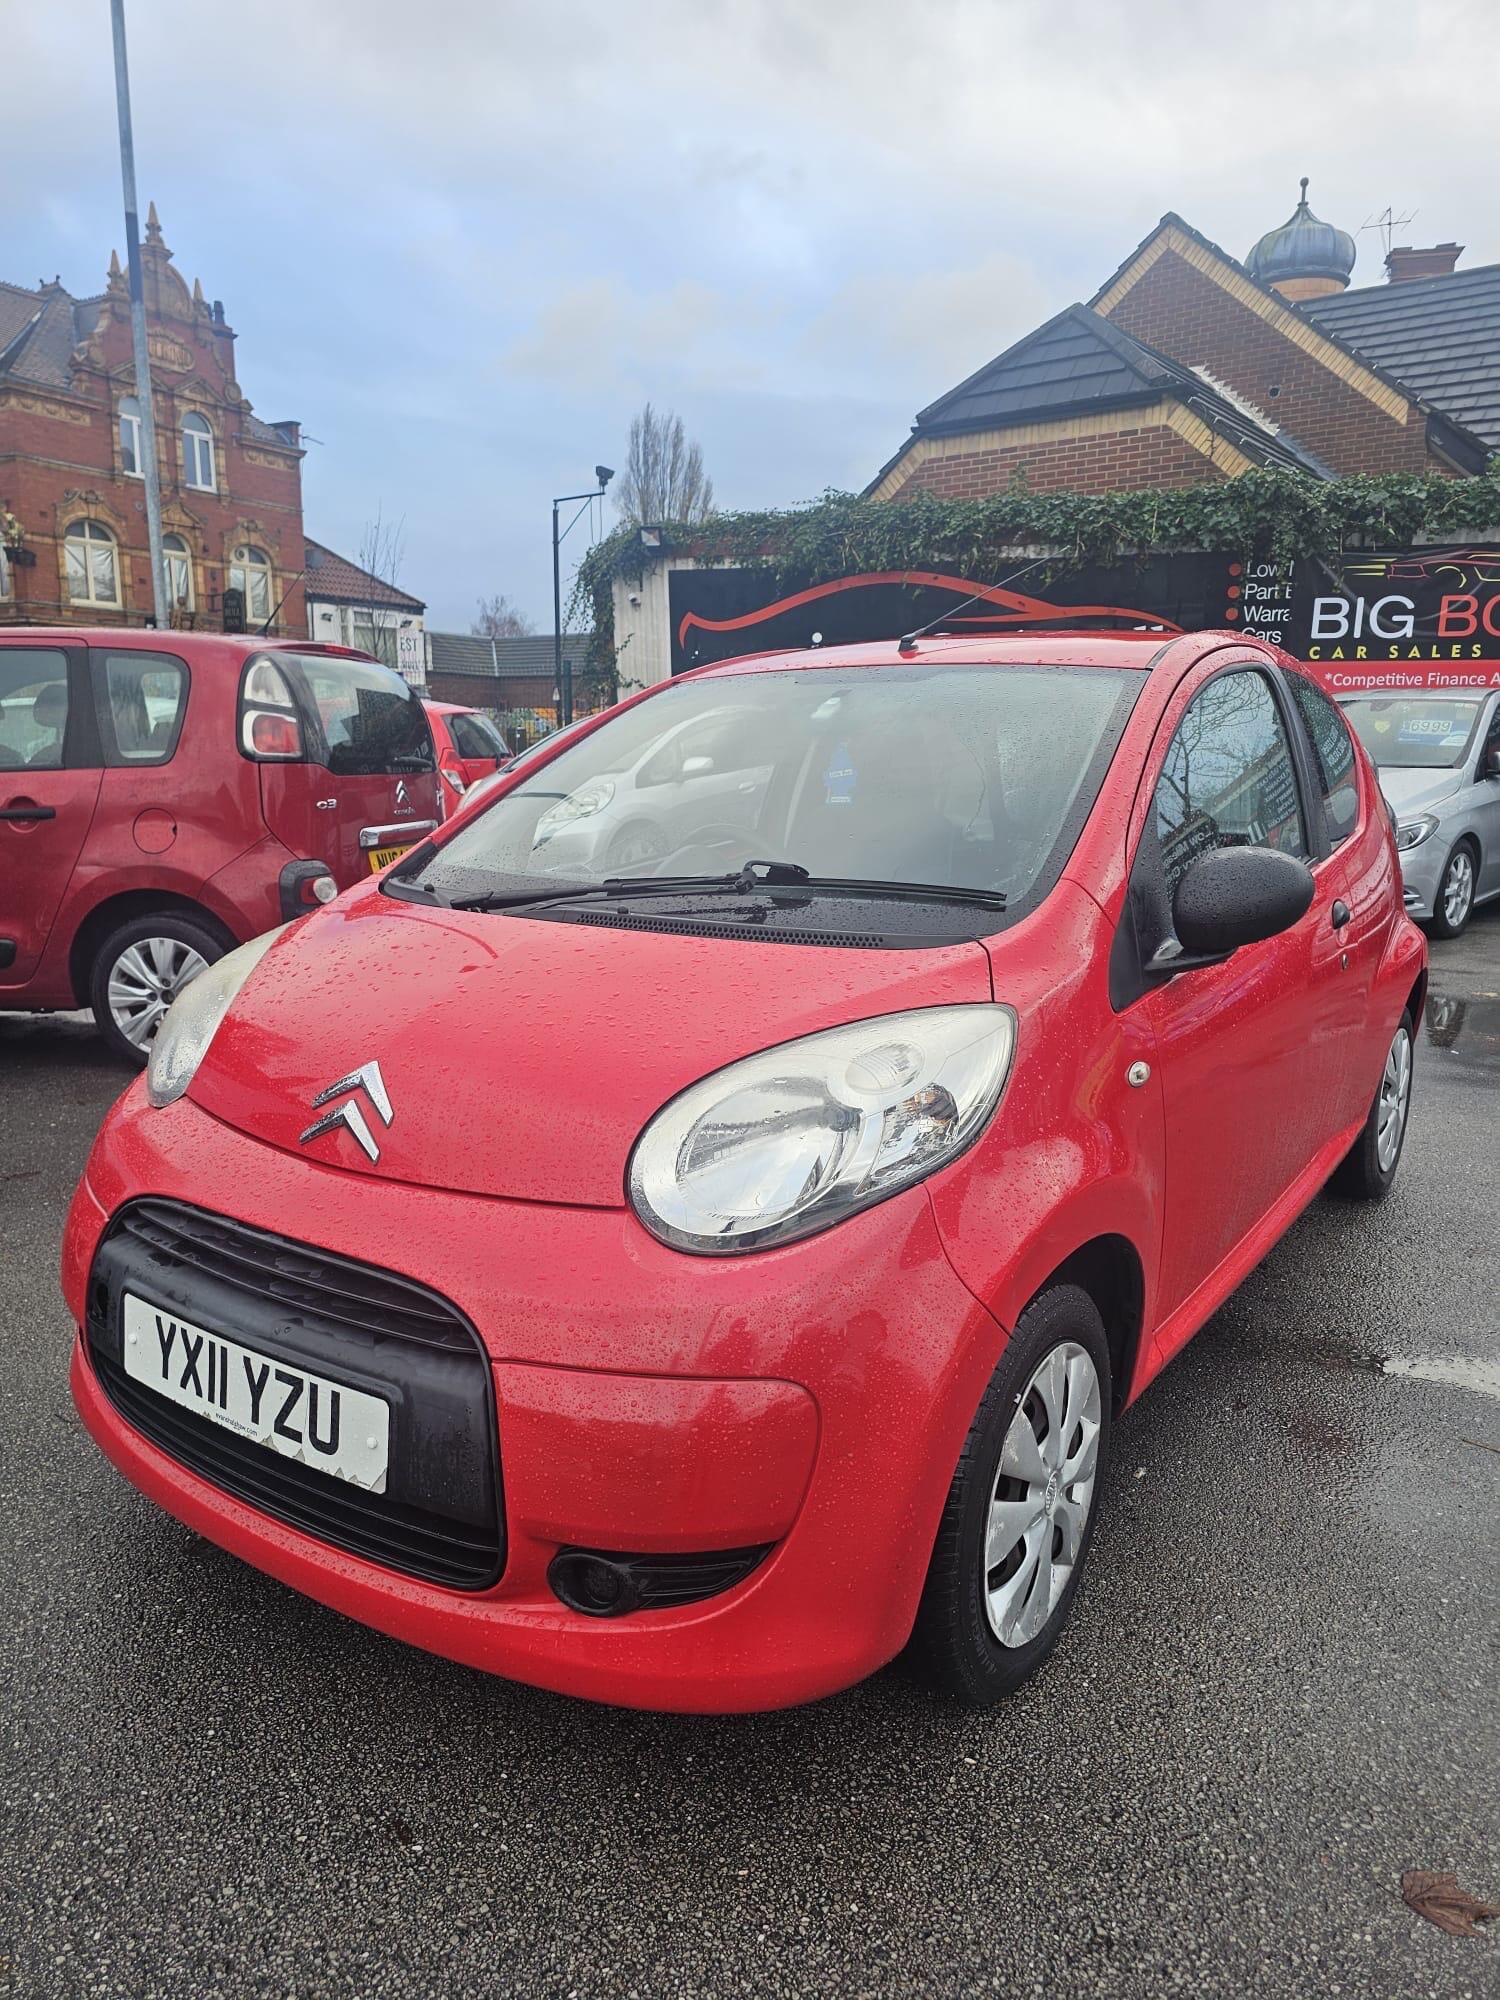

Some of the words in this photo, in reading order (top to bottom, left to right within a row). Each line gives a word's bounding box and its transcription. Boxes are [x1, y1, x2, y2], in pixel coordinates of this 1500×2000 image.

[1244, 583, 1280, 600] Part
[1310, 594, 1416, 640] BIG
[1309, 645, 1368, 660] CAR
[1388, 643, 1482, 659] SALES
[1427, 672, 1487, 686] Finance
[155, 1314, 228, 1410] YX11
[242, 1355, 341, 1456] YZU
